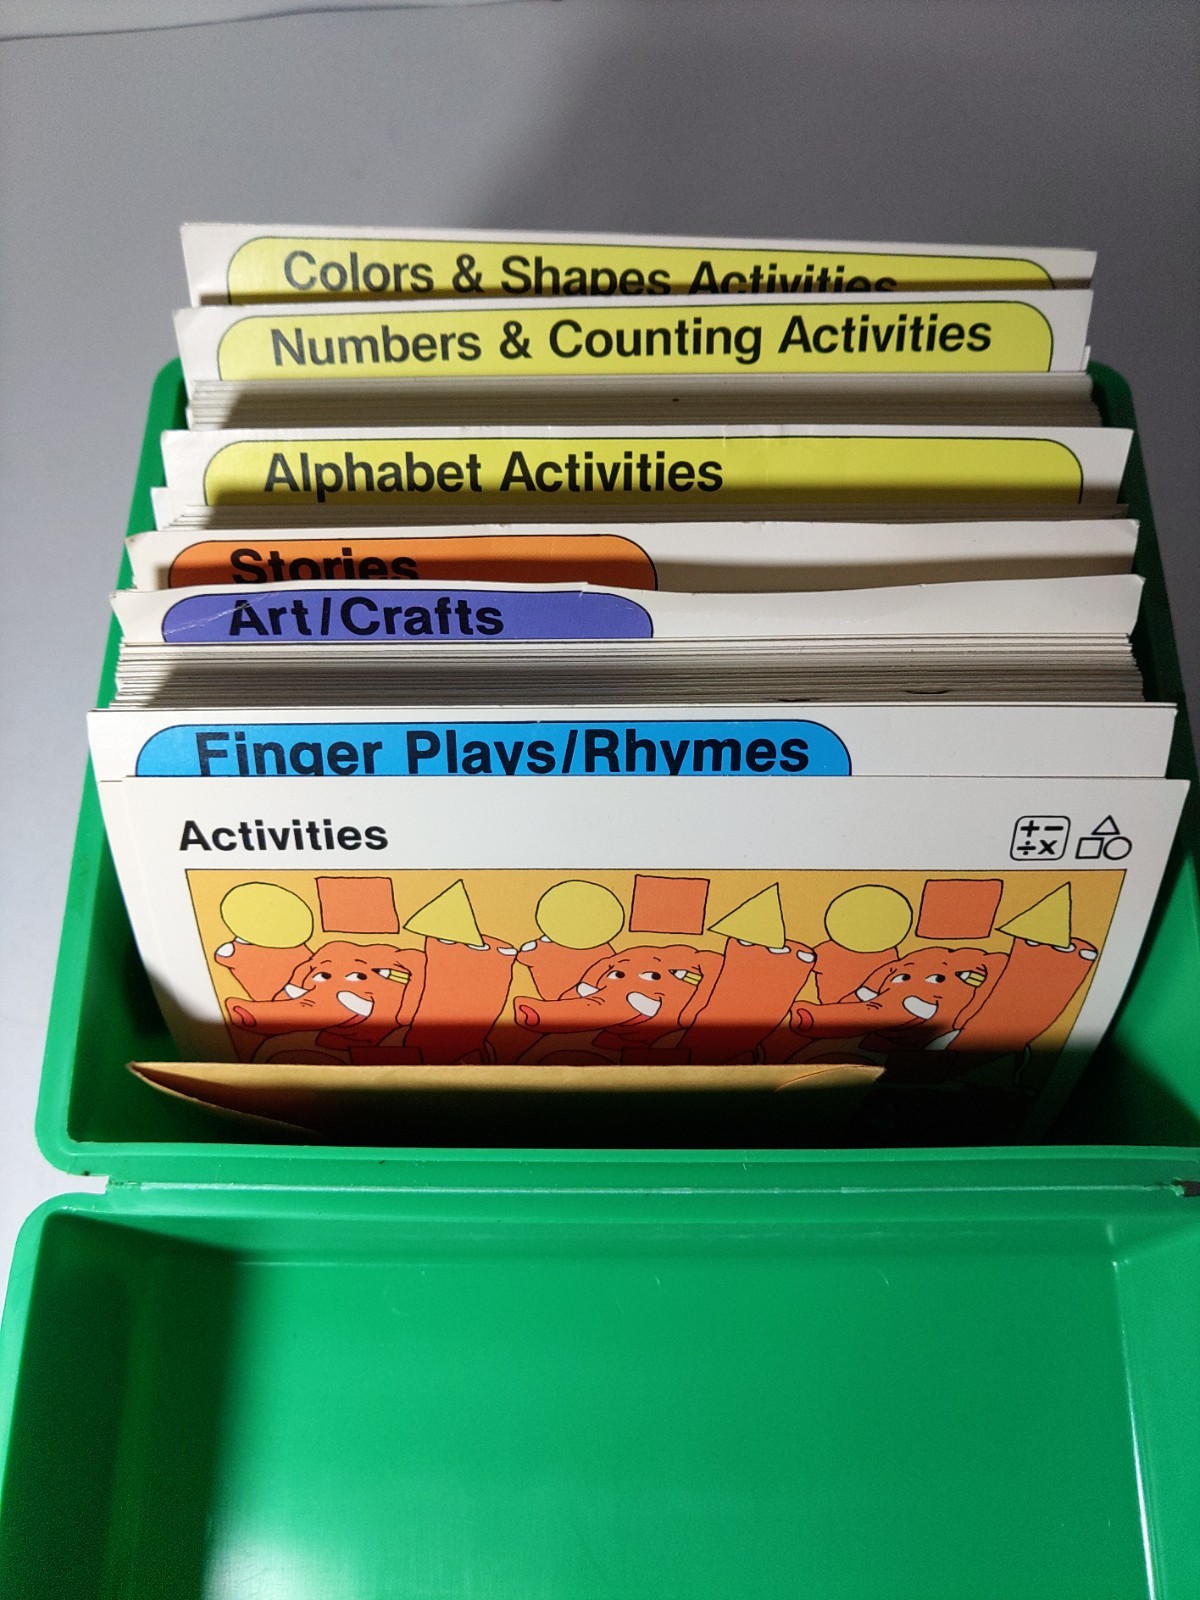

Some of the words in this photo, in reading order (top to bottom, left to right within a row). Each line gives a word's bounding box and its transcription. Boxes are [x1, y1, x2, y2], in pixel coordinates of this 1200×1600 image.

[284, 250, 435, 293] Colors
[451, 253, 484, 294] &
[501, 255, 672, 297] Shapes
[688, 260, 899, 295] Activities
[271, 325, 483, 367] Numbers
[499, 320, 533, 360] &
[549, 315, 763, 365] Counting
[778, 312, 993, 354] Activities
[264, 450, 483, 503] Alphabet
[499, 450, 724, 492] Activities
[230, 547, 419, 582] Stories
[228, 597, 505, 637] Art/Crafts
[195, 730, 383, 776] Finger
[406, 728, 810, 776] Plays/Rhymes
[179, 819, 389, 852] Activities
